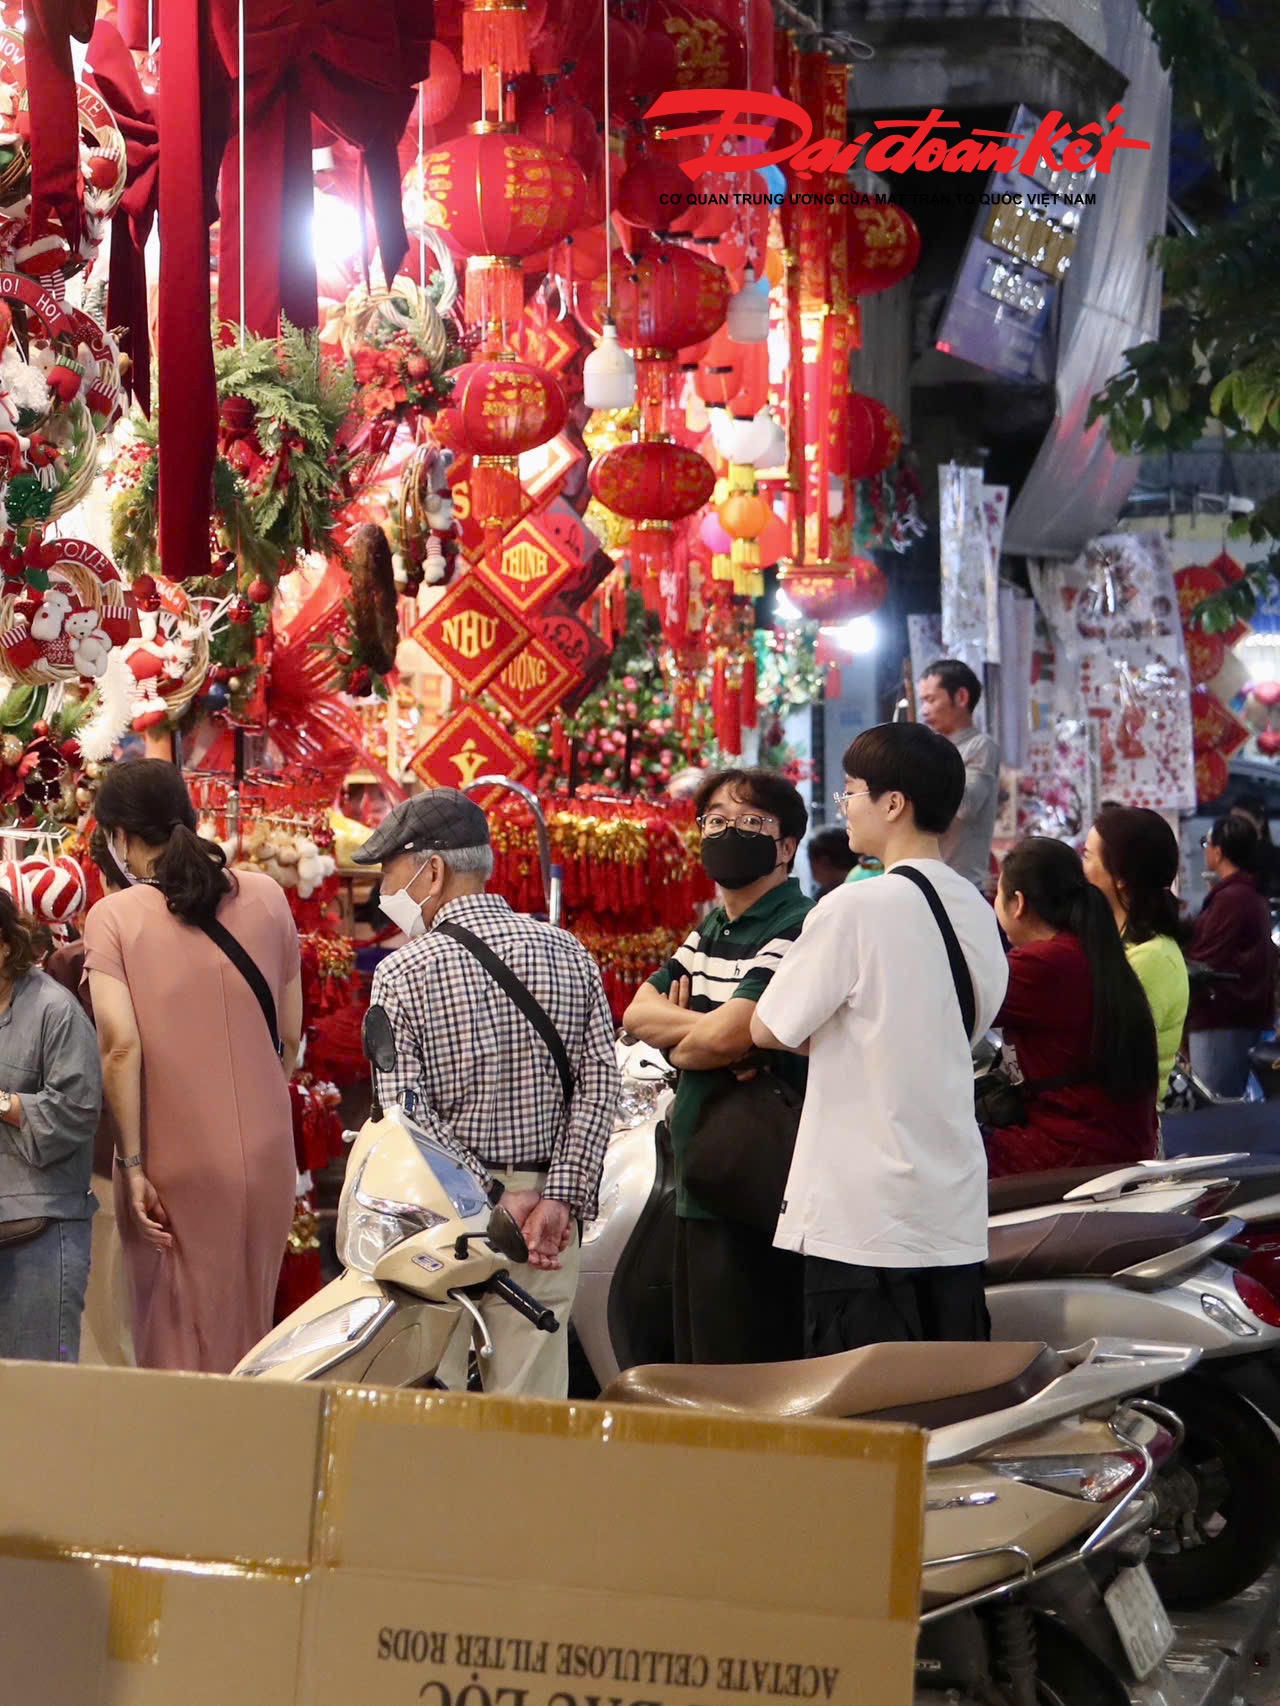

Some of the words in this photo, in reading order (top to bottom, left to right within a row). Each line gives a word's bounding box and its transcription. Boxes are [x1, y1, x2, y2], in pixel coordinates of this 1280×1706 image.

[36, 294, 61, 323] HO!
[448, 738, 489, 791] Ý
[377, 1627, 448, 1665] RODS
[455, 1634, 549, 1673] FILTER
[556, 1643, 709, 1688] CELLULOSE
[717, 1657, 841, 1699] ACETATE
